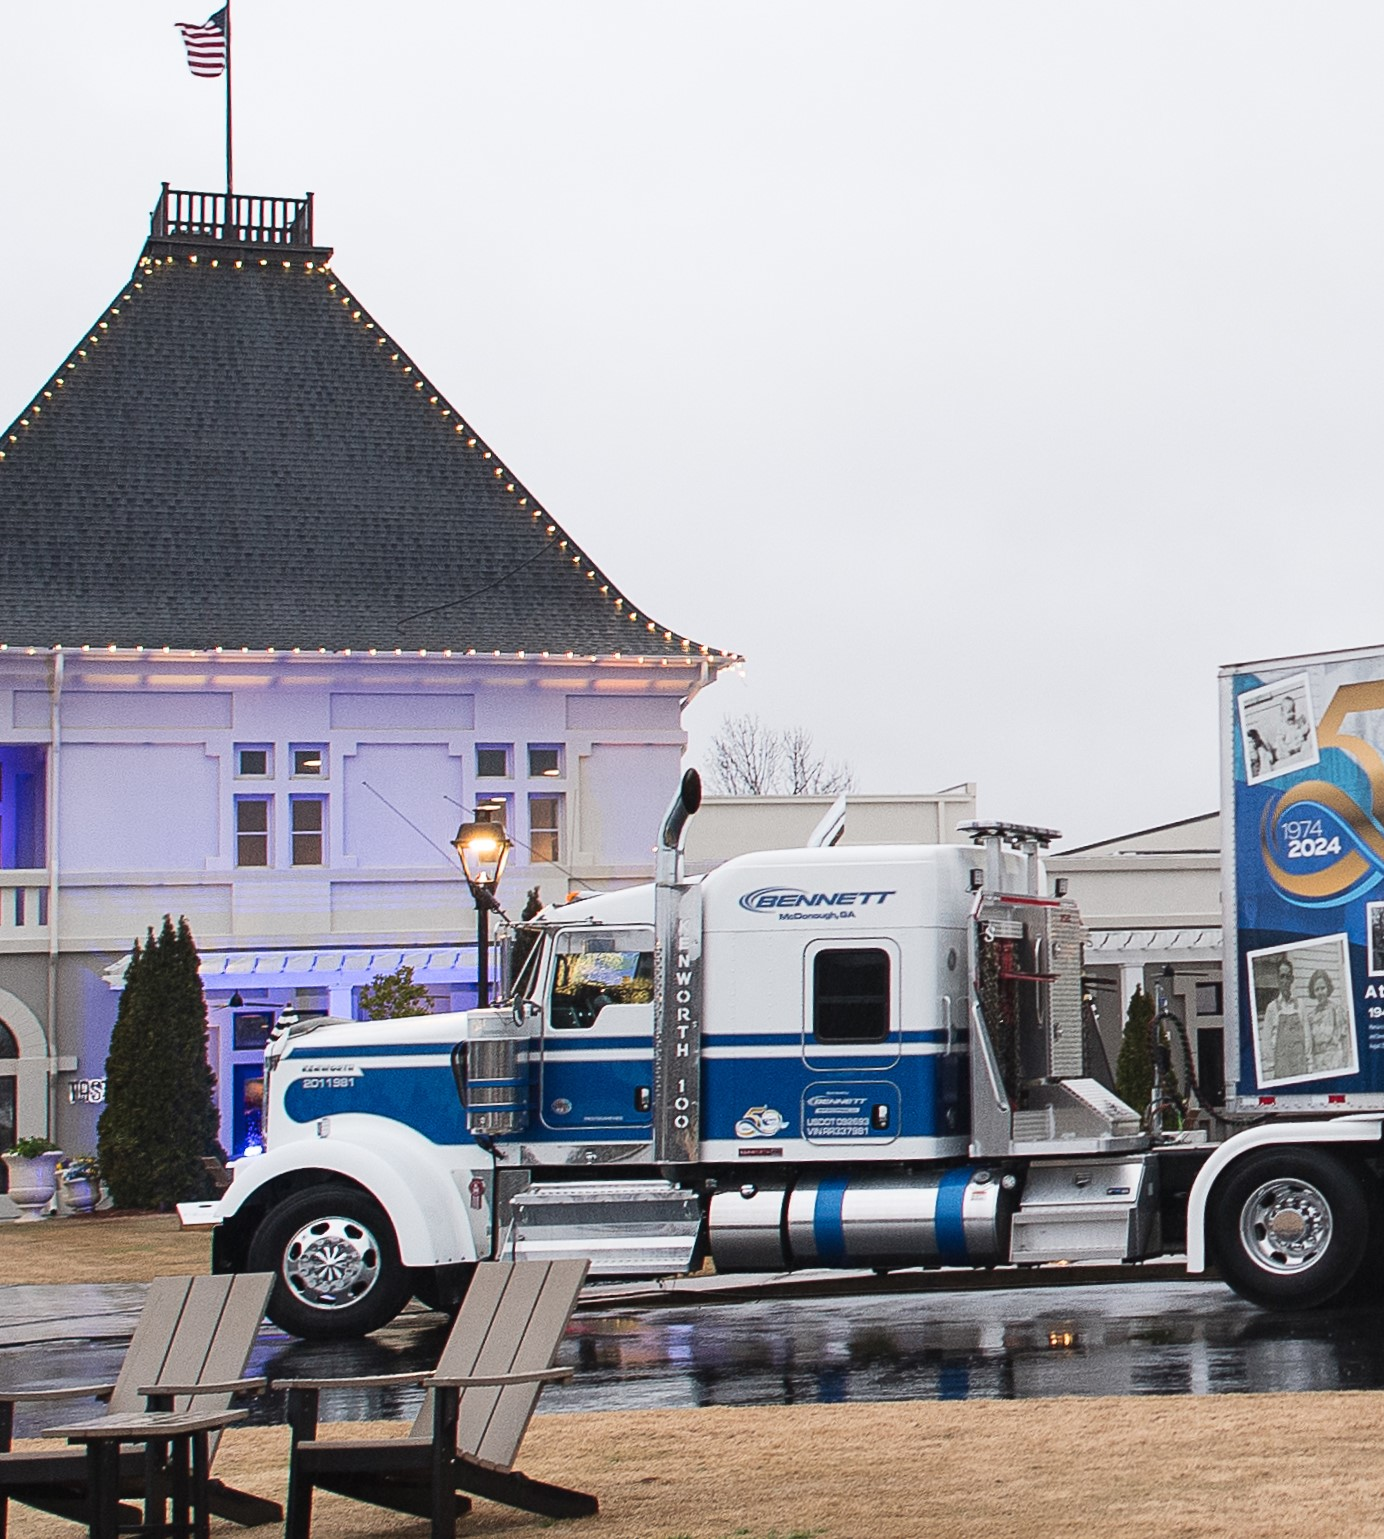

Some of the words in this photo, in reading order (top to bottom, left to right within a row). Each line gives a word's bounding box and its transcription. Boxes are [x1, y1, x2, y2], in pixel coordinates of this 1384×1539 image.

[1281, 820, 1323, 840] 1974
[1288, 836, 1342, 858] 2024
[755, 890, 896, 908] BENNETT
[675, 918, 693, 1057] KENWORTH
[1365, 984, 1377, 999] A
[68, 1079, 106, 1103] TAS
[674, 1078, 690, 1129] 100
